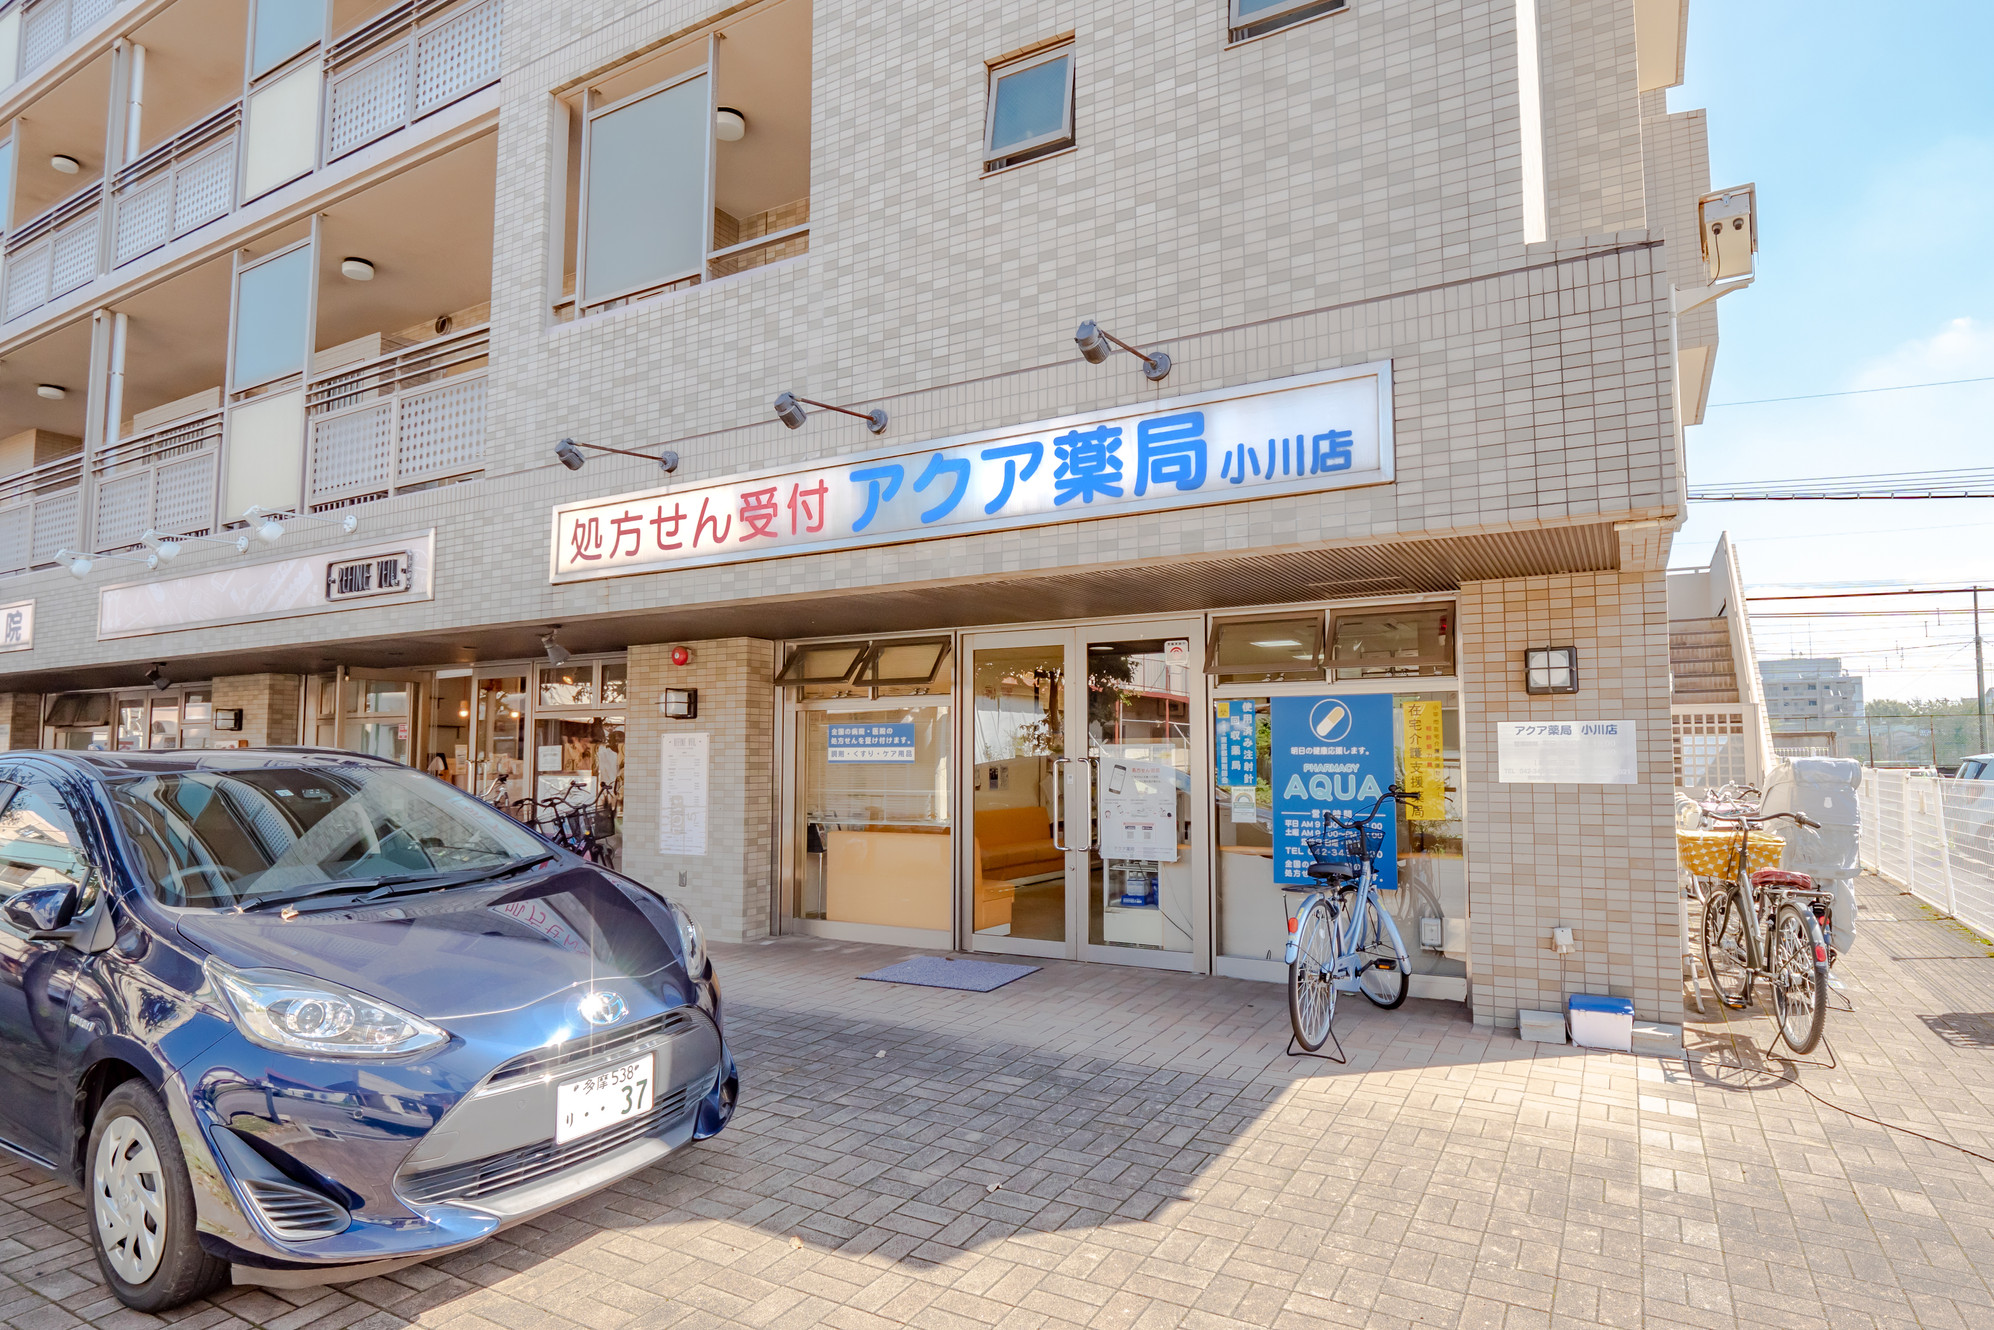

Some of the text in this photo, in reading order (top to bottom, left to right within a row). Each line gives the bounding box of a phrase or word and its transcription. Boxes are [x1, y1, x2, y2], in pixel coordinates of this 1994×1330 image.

[570, 411, 1354, 564] 処方せん受付 アクア薬局 小川店
[338, 563, 372, 594] REFINE
[6, 611, 23, 642] 院
[1242, 702, 1254, 784] 使用済み注射針
[1515, 724, 1618, 736] アクア薬局 小川店
[1303, 763, 1360, 773] PHARMACY
[1283, 774, 1384, 802] AQUA
[1285, 847, 1304, 855] TEL
[583, 1065, 633, 1095] 多摩 538
